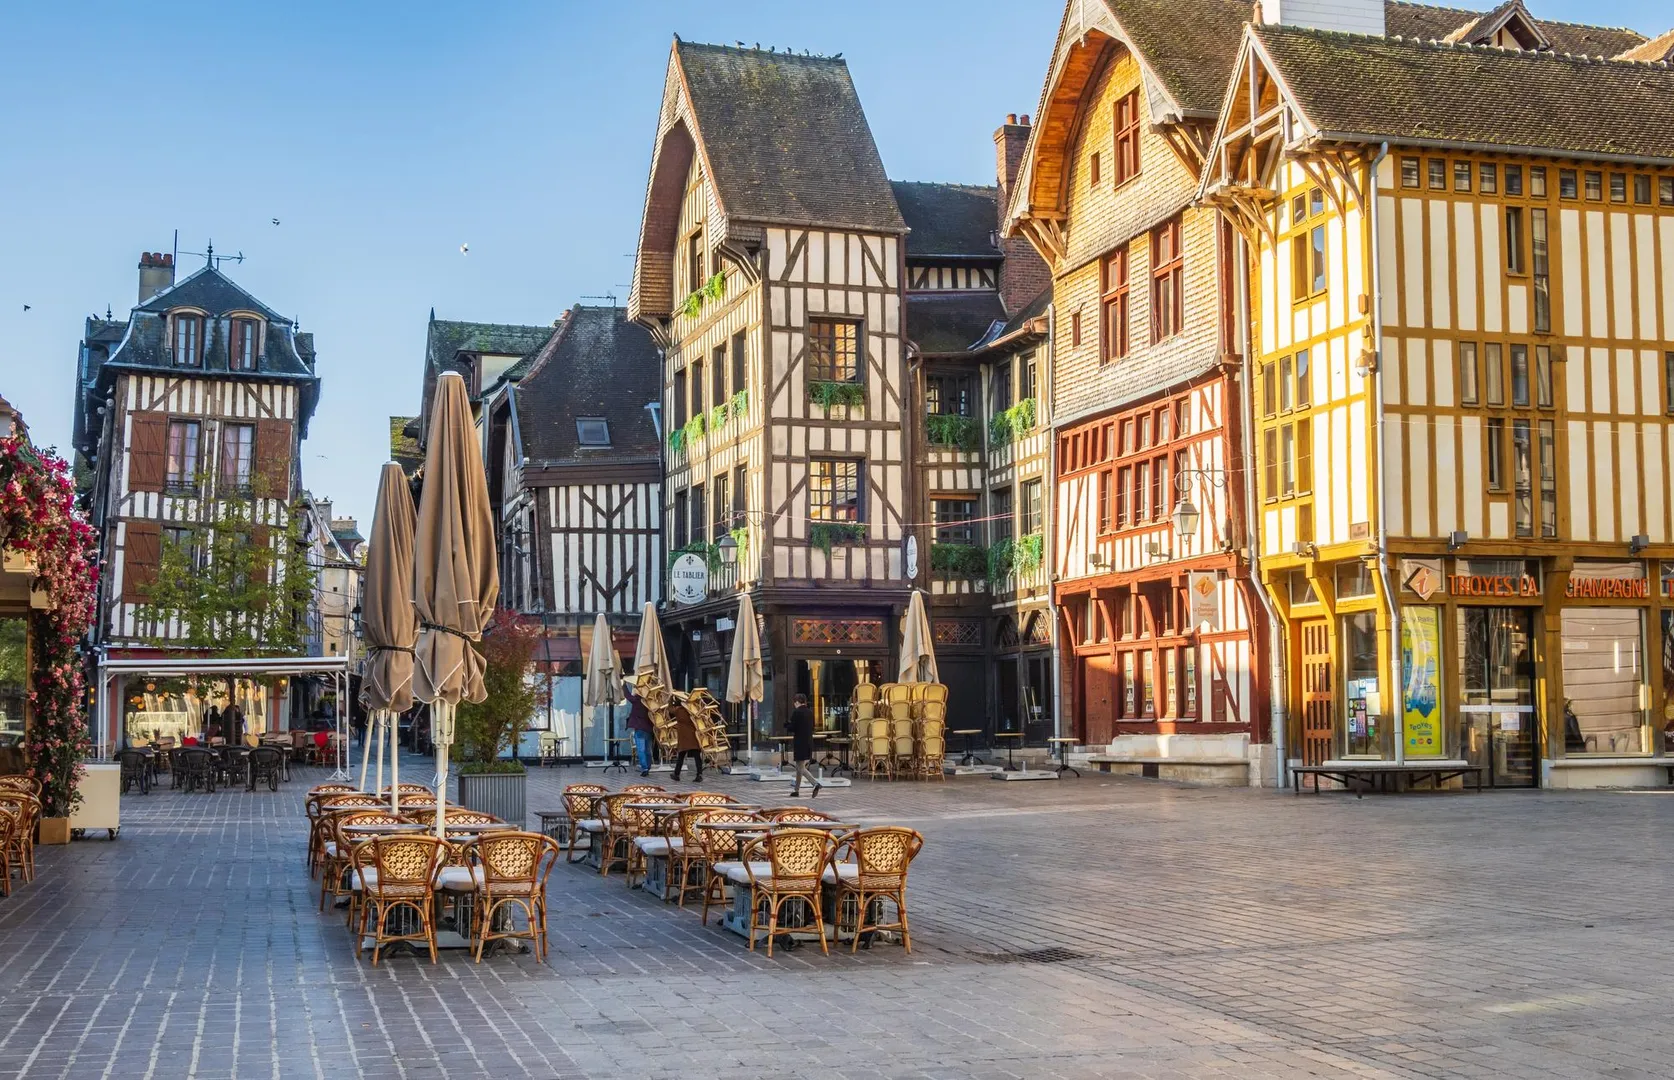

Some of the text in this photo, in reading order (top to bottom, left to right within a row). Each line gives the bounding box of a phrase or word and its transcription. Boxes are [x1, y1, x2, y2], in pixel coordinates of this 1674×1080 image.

[674, 570, 704, 579] LE TABLIER
[1448, 574, 1514, 597] TROYES
[1520, 575, 1538, 597] LA
[1565, 577, 1648, 598] CHAMPAGNE
